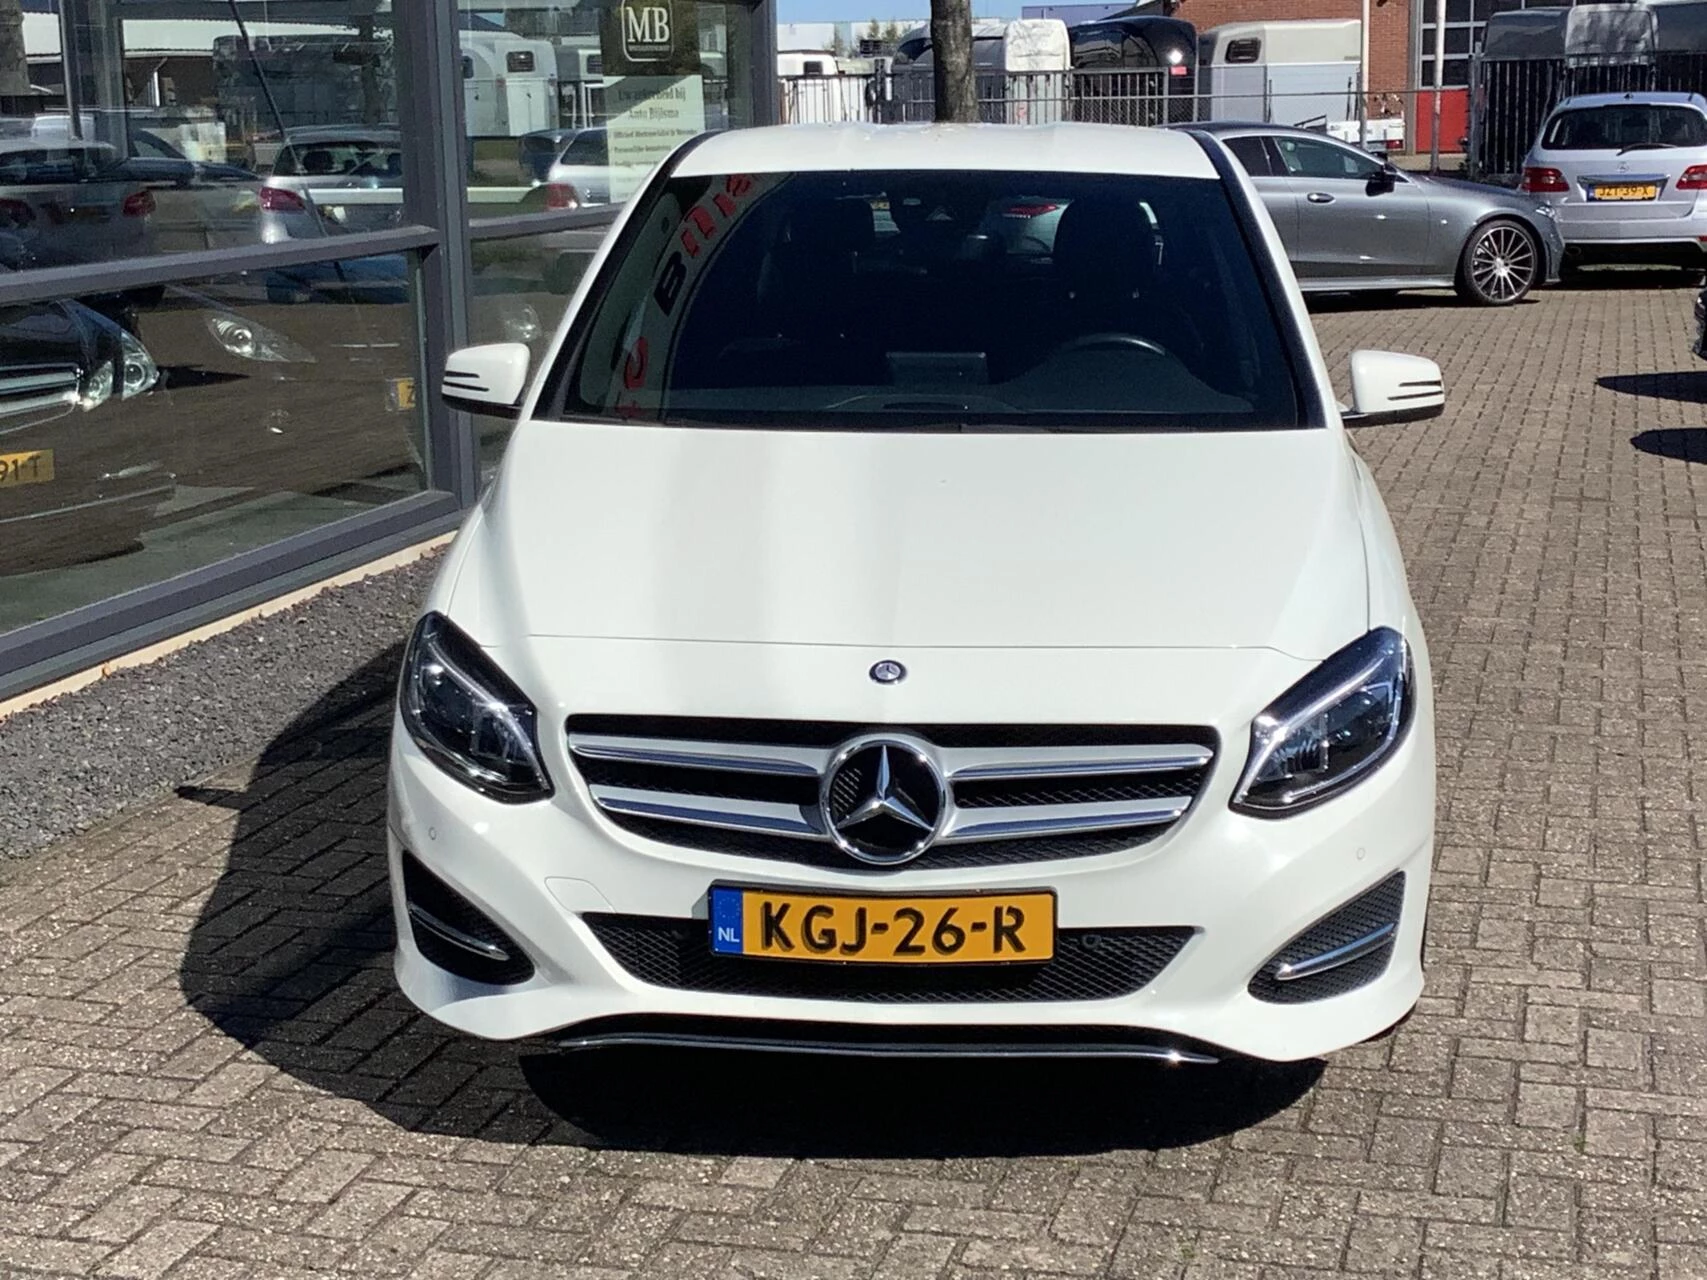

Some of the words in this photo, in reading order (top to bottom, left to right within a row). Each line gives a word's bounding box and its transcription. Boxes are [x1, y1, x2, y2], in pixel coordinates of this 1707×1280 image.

[626, 7, 670, 43] MB
[717, 927, 740, 943] NL
[760, 901, 1027, 956] KGJ-26-R
